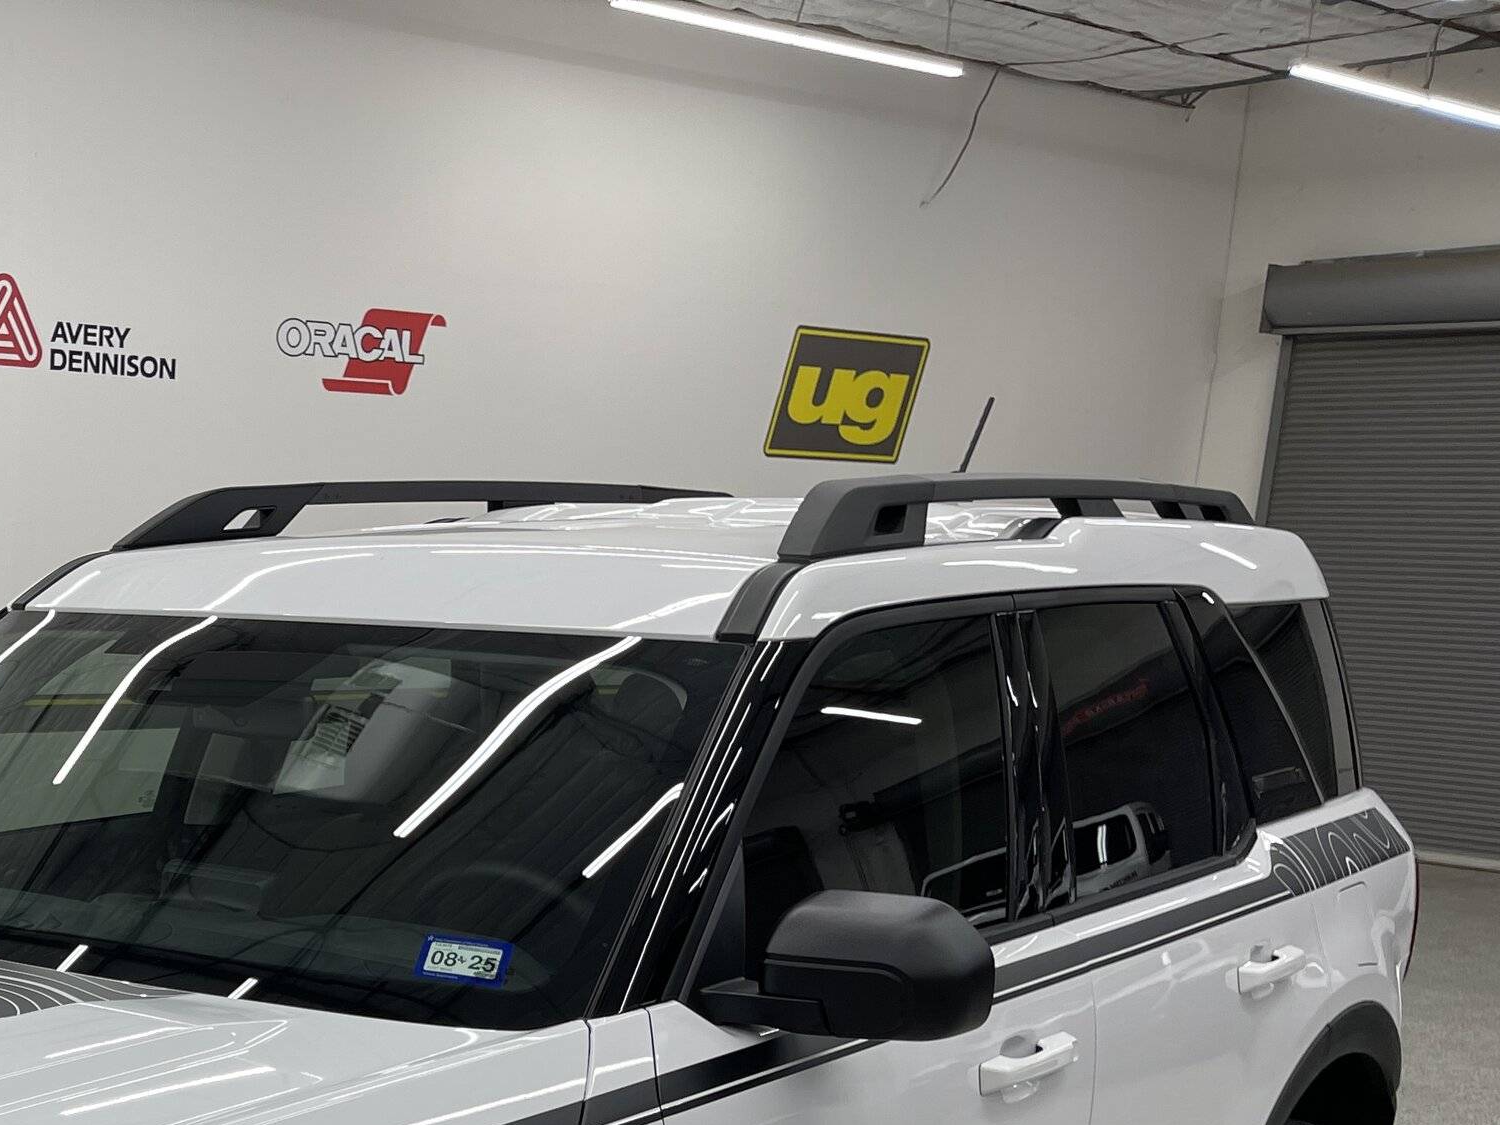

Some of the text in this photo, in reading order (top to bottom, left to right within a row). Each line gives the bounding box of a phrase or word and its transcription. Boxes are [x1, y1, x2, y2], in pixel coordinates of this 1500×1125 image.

[49, 320, 132, 349] AVERY
[276, 317, 425, 365] ORACAL
[49, 348, 178, 380] DENNISON
[787, 365, 910, 446] ug
[430, 949, 458, 967] 08
[467, 954, 497, 973] 25
